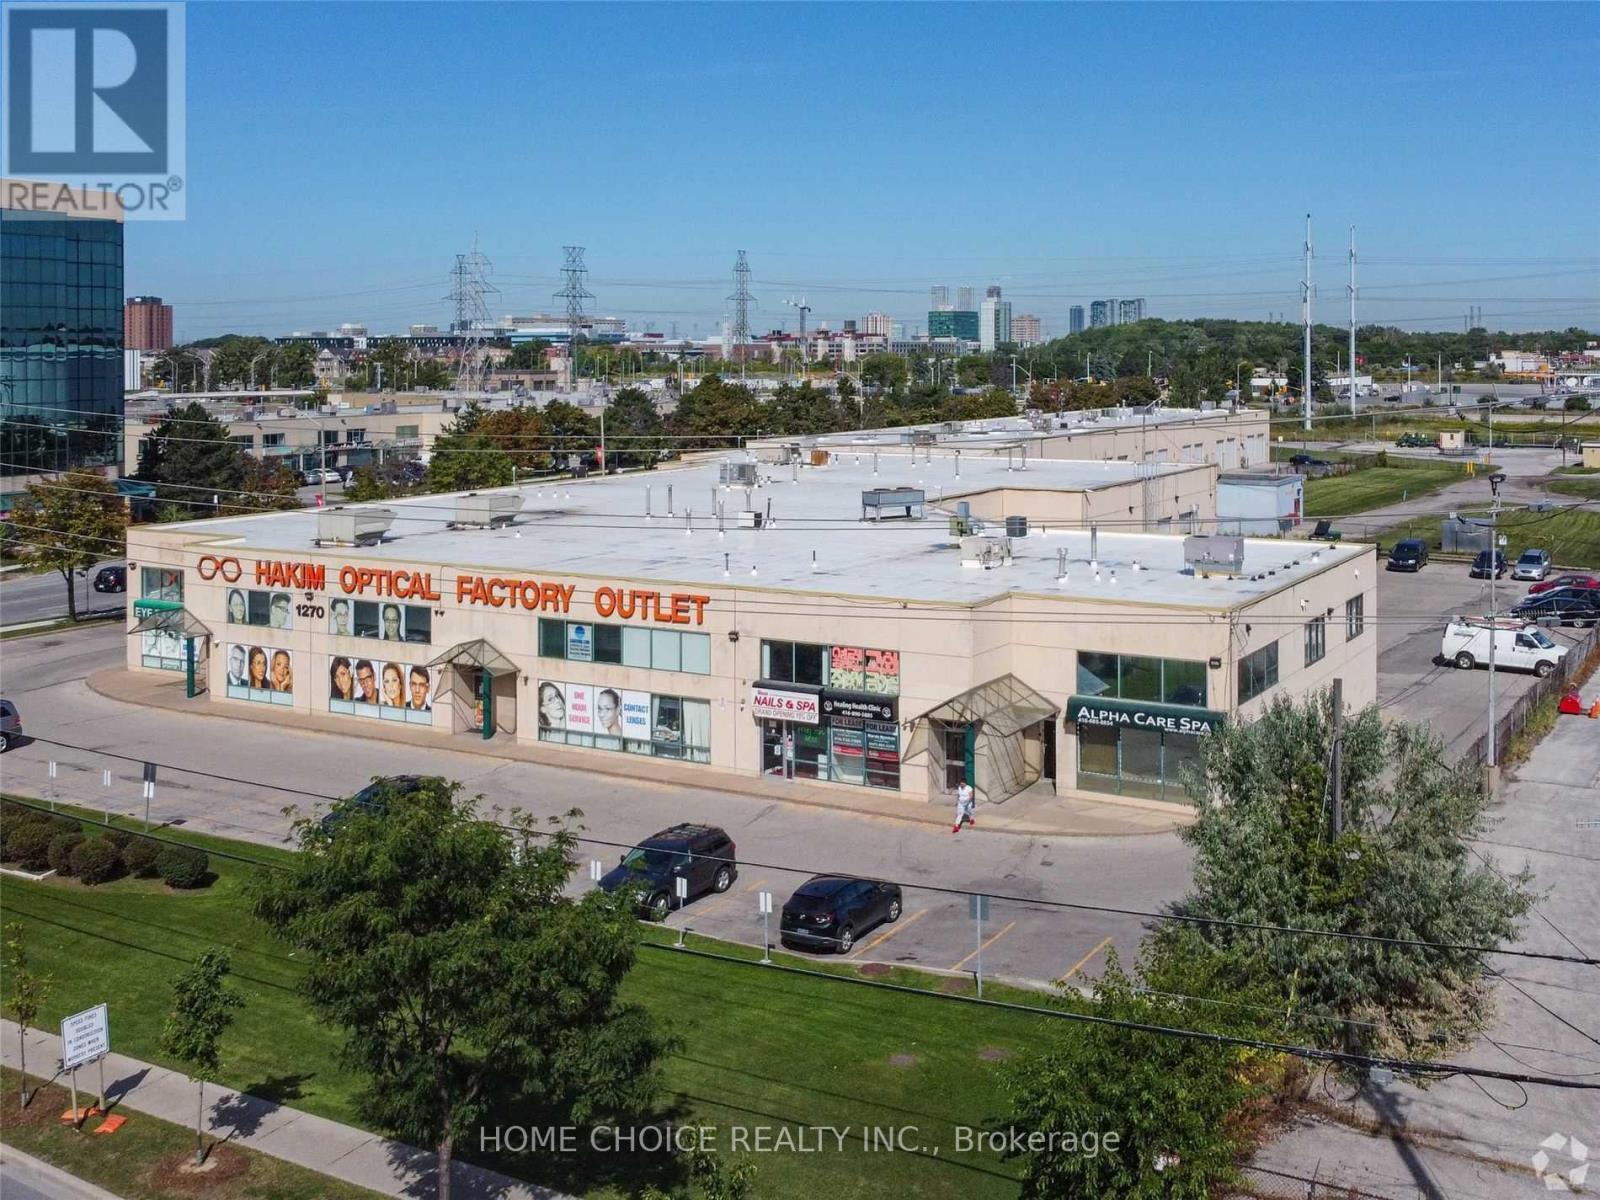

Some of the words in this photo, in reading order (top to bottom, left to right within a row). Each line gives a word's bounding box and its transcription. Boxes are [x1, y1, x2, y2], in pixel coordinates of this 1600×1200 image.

[255, 560, 326, 591] HAKIM
[339, 565, 441, 601] OPTICAL
[456, 575, 576, 613] FACTORY
[595, 586, 710, 626] OUTLET
[295, 604, 325, 619] 1270
[623, 703, 649, 713] CONTACT
[753, 695, 784, 708] NAILS
[785, 699, 794, 709] &
[796, 700, 816, 712] SPA
[833, 701, 852, 710] Healing
[868, 704, 882, 712] Clinic
[626, 715, 646, 725] LENSES
[1077, 706, 1131, 723] ALPHA
[1133, 713, 1176, 728] CARE
[1180, 717, 1212, 733] SPA
[866, 722, 878, 732] FOR
